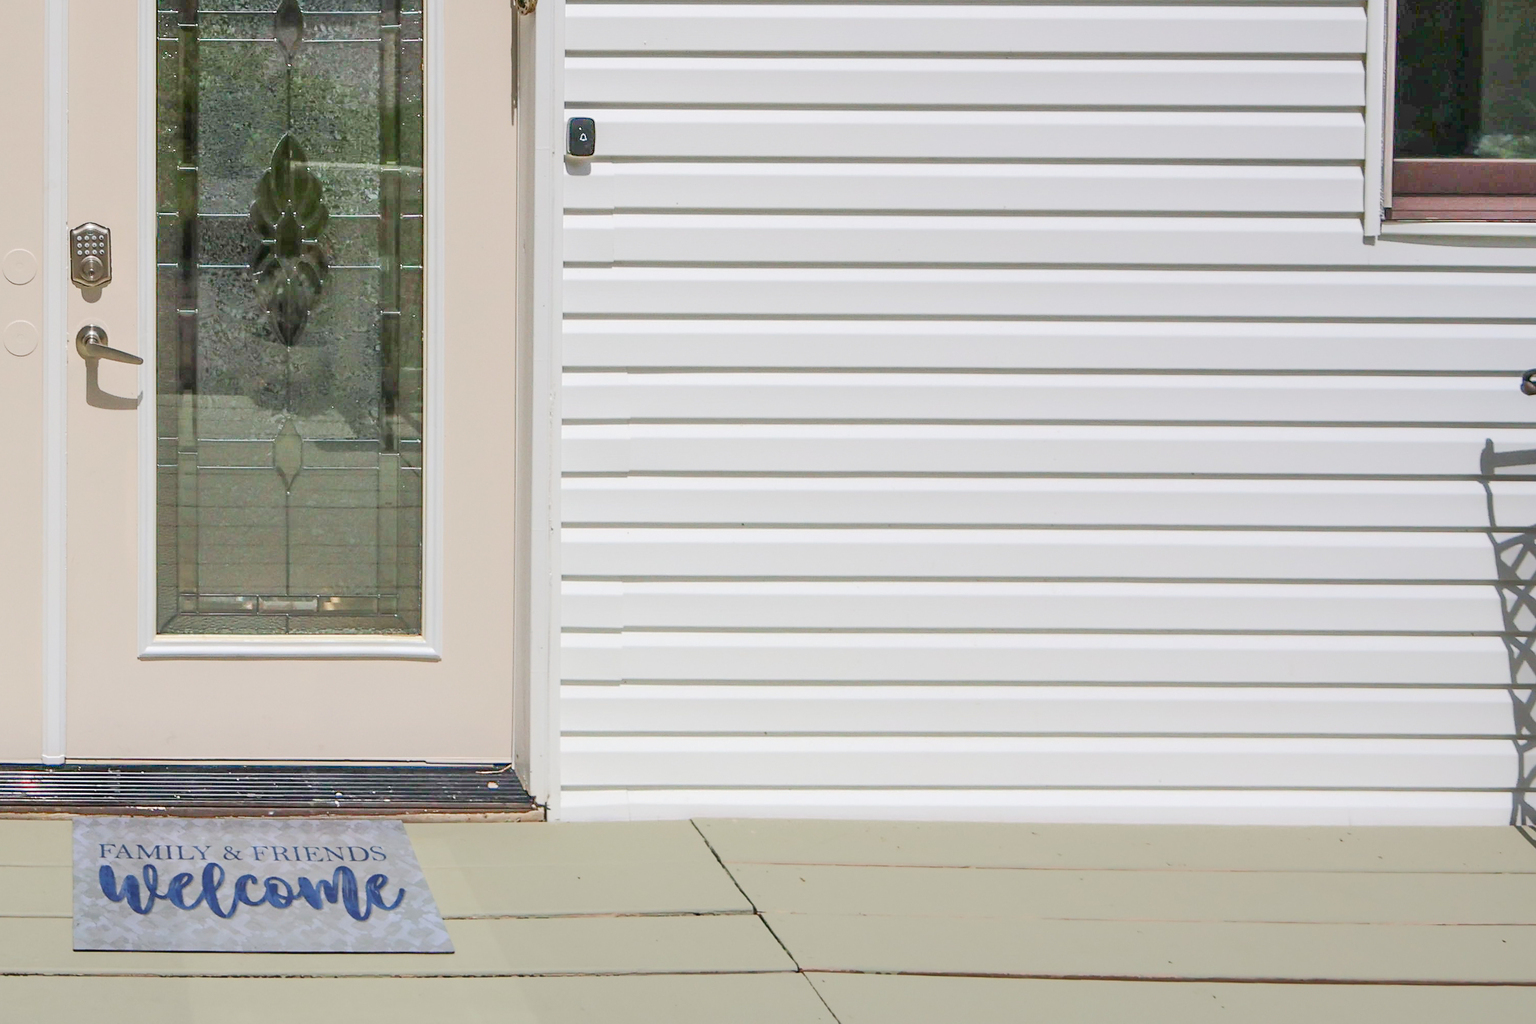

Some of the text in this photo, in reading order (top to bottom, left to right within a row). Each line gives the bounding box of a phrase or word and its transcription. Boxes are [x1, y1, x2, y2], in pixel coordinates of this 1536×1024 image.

[98, 843, 388, 862] FAMILY & FRIENDS
[98, 862, 406, 922] welcome
